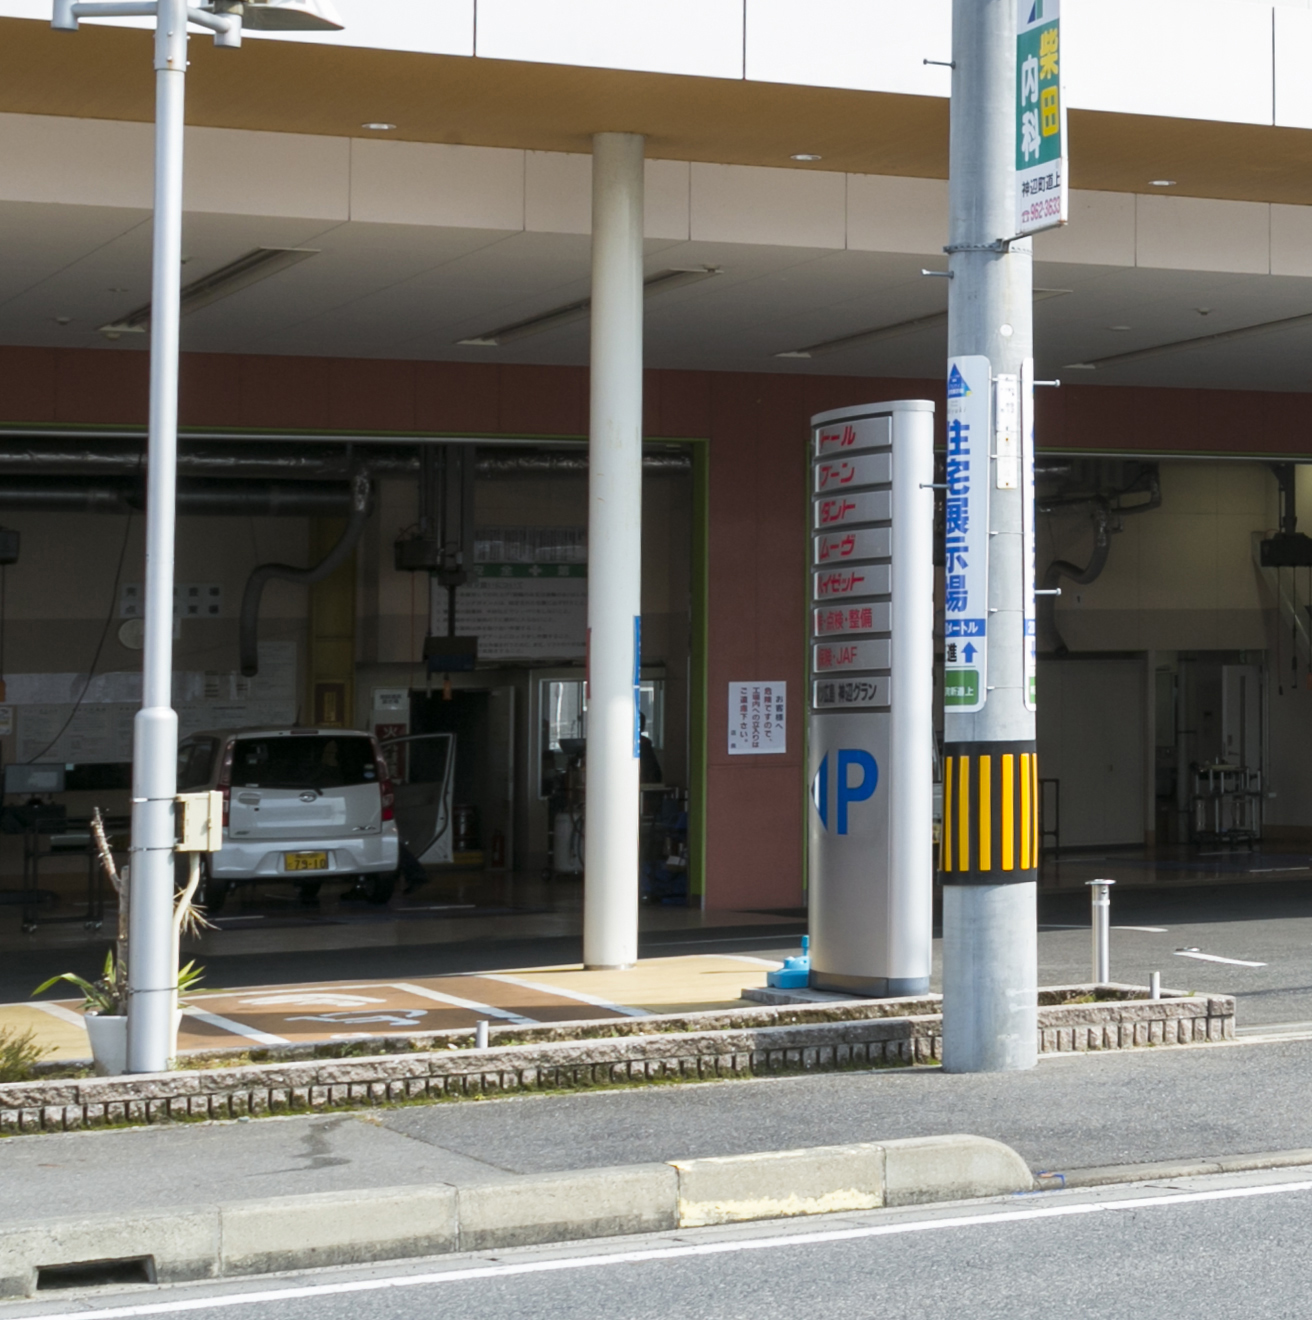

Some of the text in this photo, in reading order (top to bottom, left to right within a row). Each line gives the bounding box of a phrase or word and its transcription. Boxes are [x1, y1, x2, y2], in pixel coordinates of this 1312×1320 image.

[1021, 53, 1042, 162] 内科
[1040, 27, 1060, 138] 柴田
[836, 748, 879, 835] P
